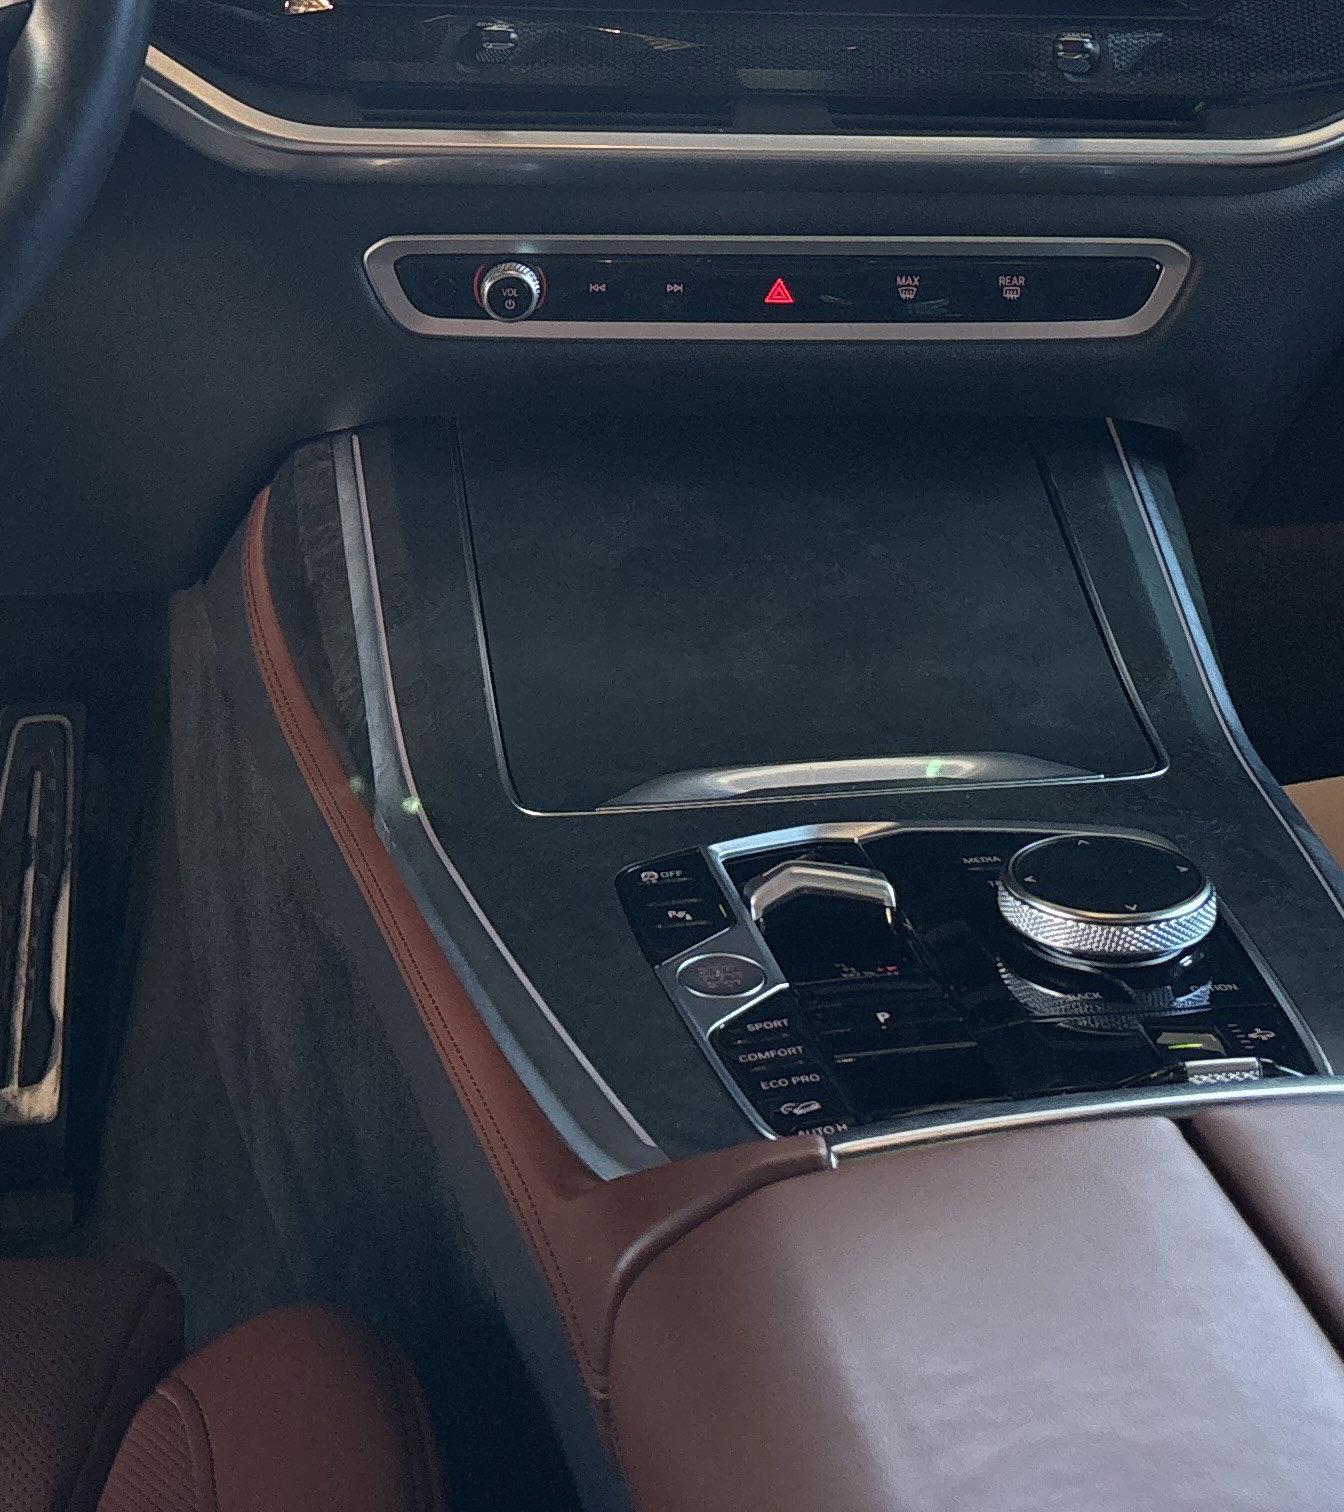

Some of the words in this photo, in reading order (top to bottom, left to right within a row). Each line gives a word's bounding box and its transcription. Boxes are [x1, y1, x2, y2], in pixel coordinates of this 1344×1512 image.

[896, 275, 920, 286] MAX
[999, 275, 1026, 286] REAR
[502, 288, 519, 298] VOL
[660, 870, 683, 879] OFF
[875, 1011, 891, 1024] P
[746, 1018, 789, 1033] SPORT
[738, 1045, 804, 1063] COMFORT
[760, 1078, 789, 1090] ECO
[792, 1073, 821, 1085] PRO
